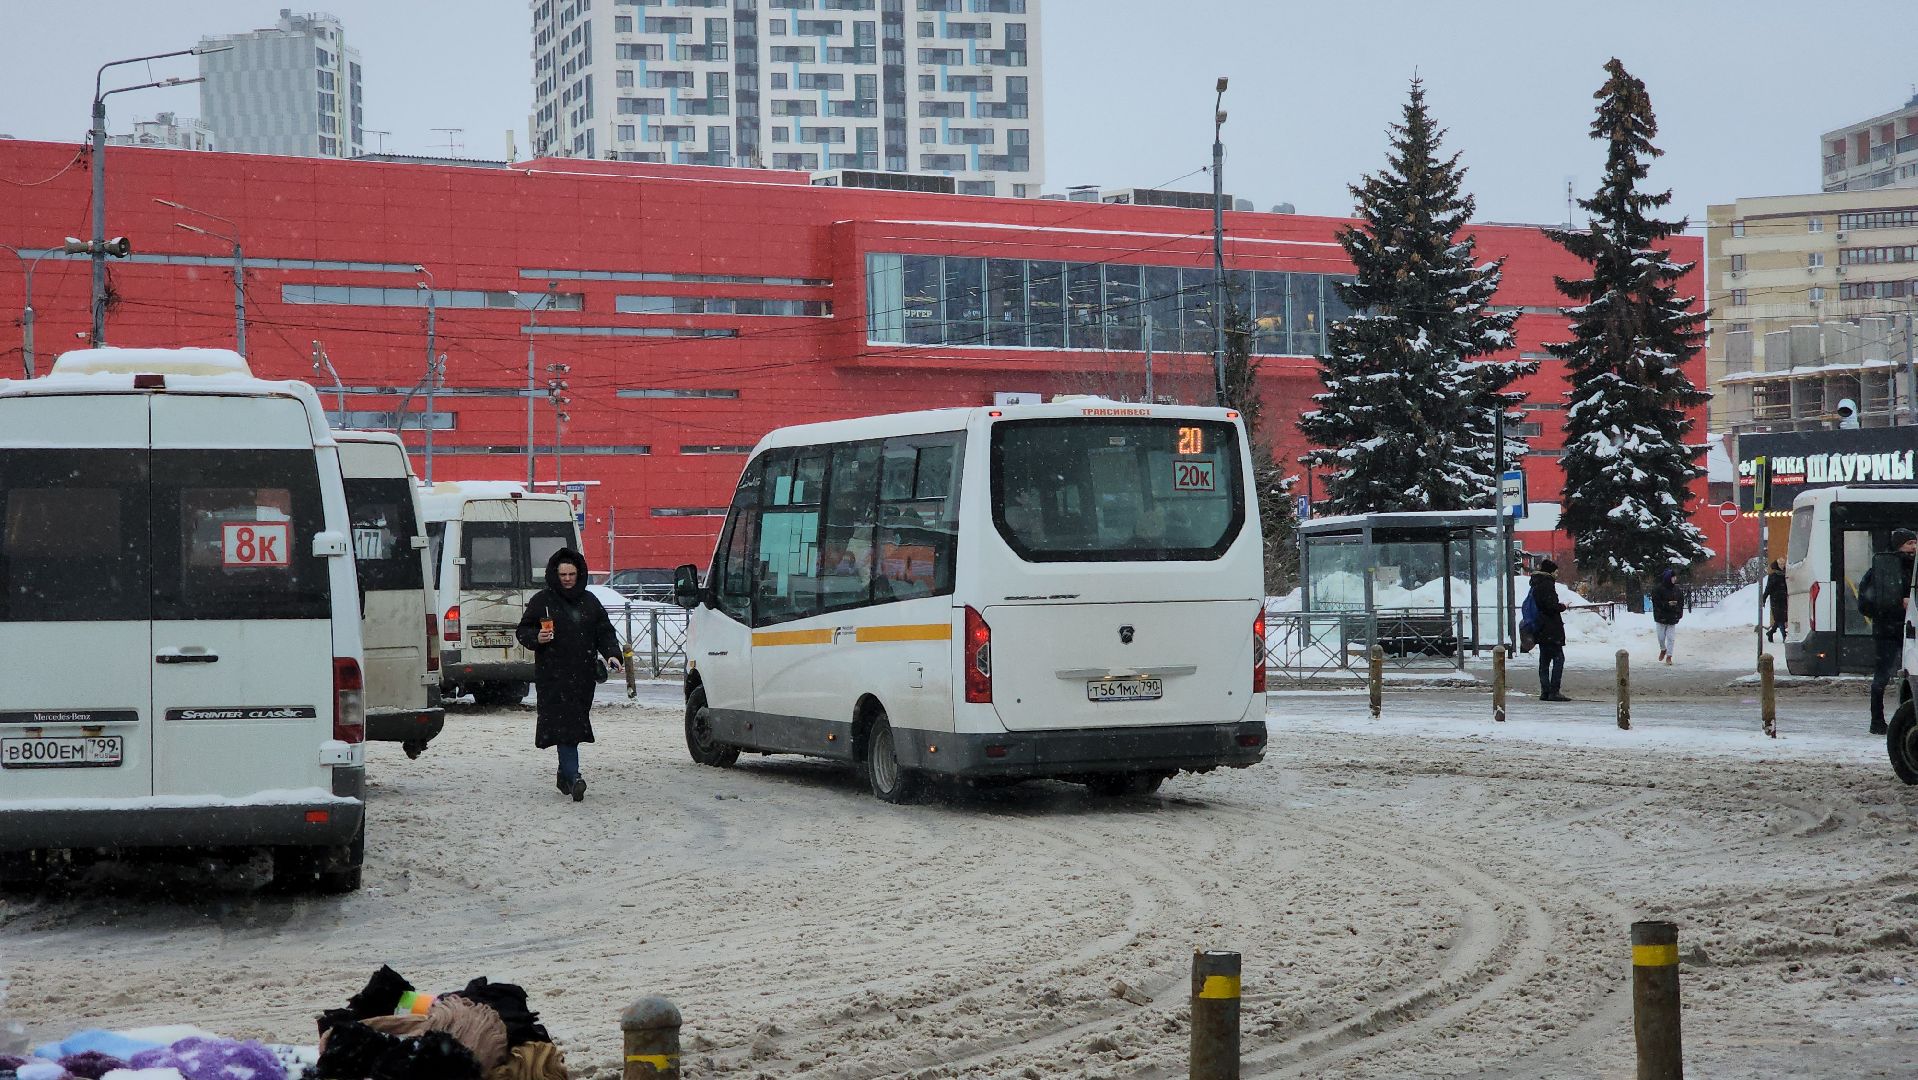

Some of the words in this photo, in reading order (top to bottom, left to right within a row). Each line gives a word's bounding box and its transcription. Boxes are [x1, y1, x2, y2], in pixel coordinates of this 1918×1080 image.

[1081, 408, 1151, 417] ТРАНСИНВЕСТ
[1178, 427, 1202, 454] 20
[1806, 450, 1915, 483] ШАУРМЫ
[1140, 681, 1158, 692] 790
[33, 713, 91, 721] Mercedes-Benz
[88, 739, 116, 752] 799
